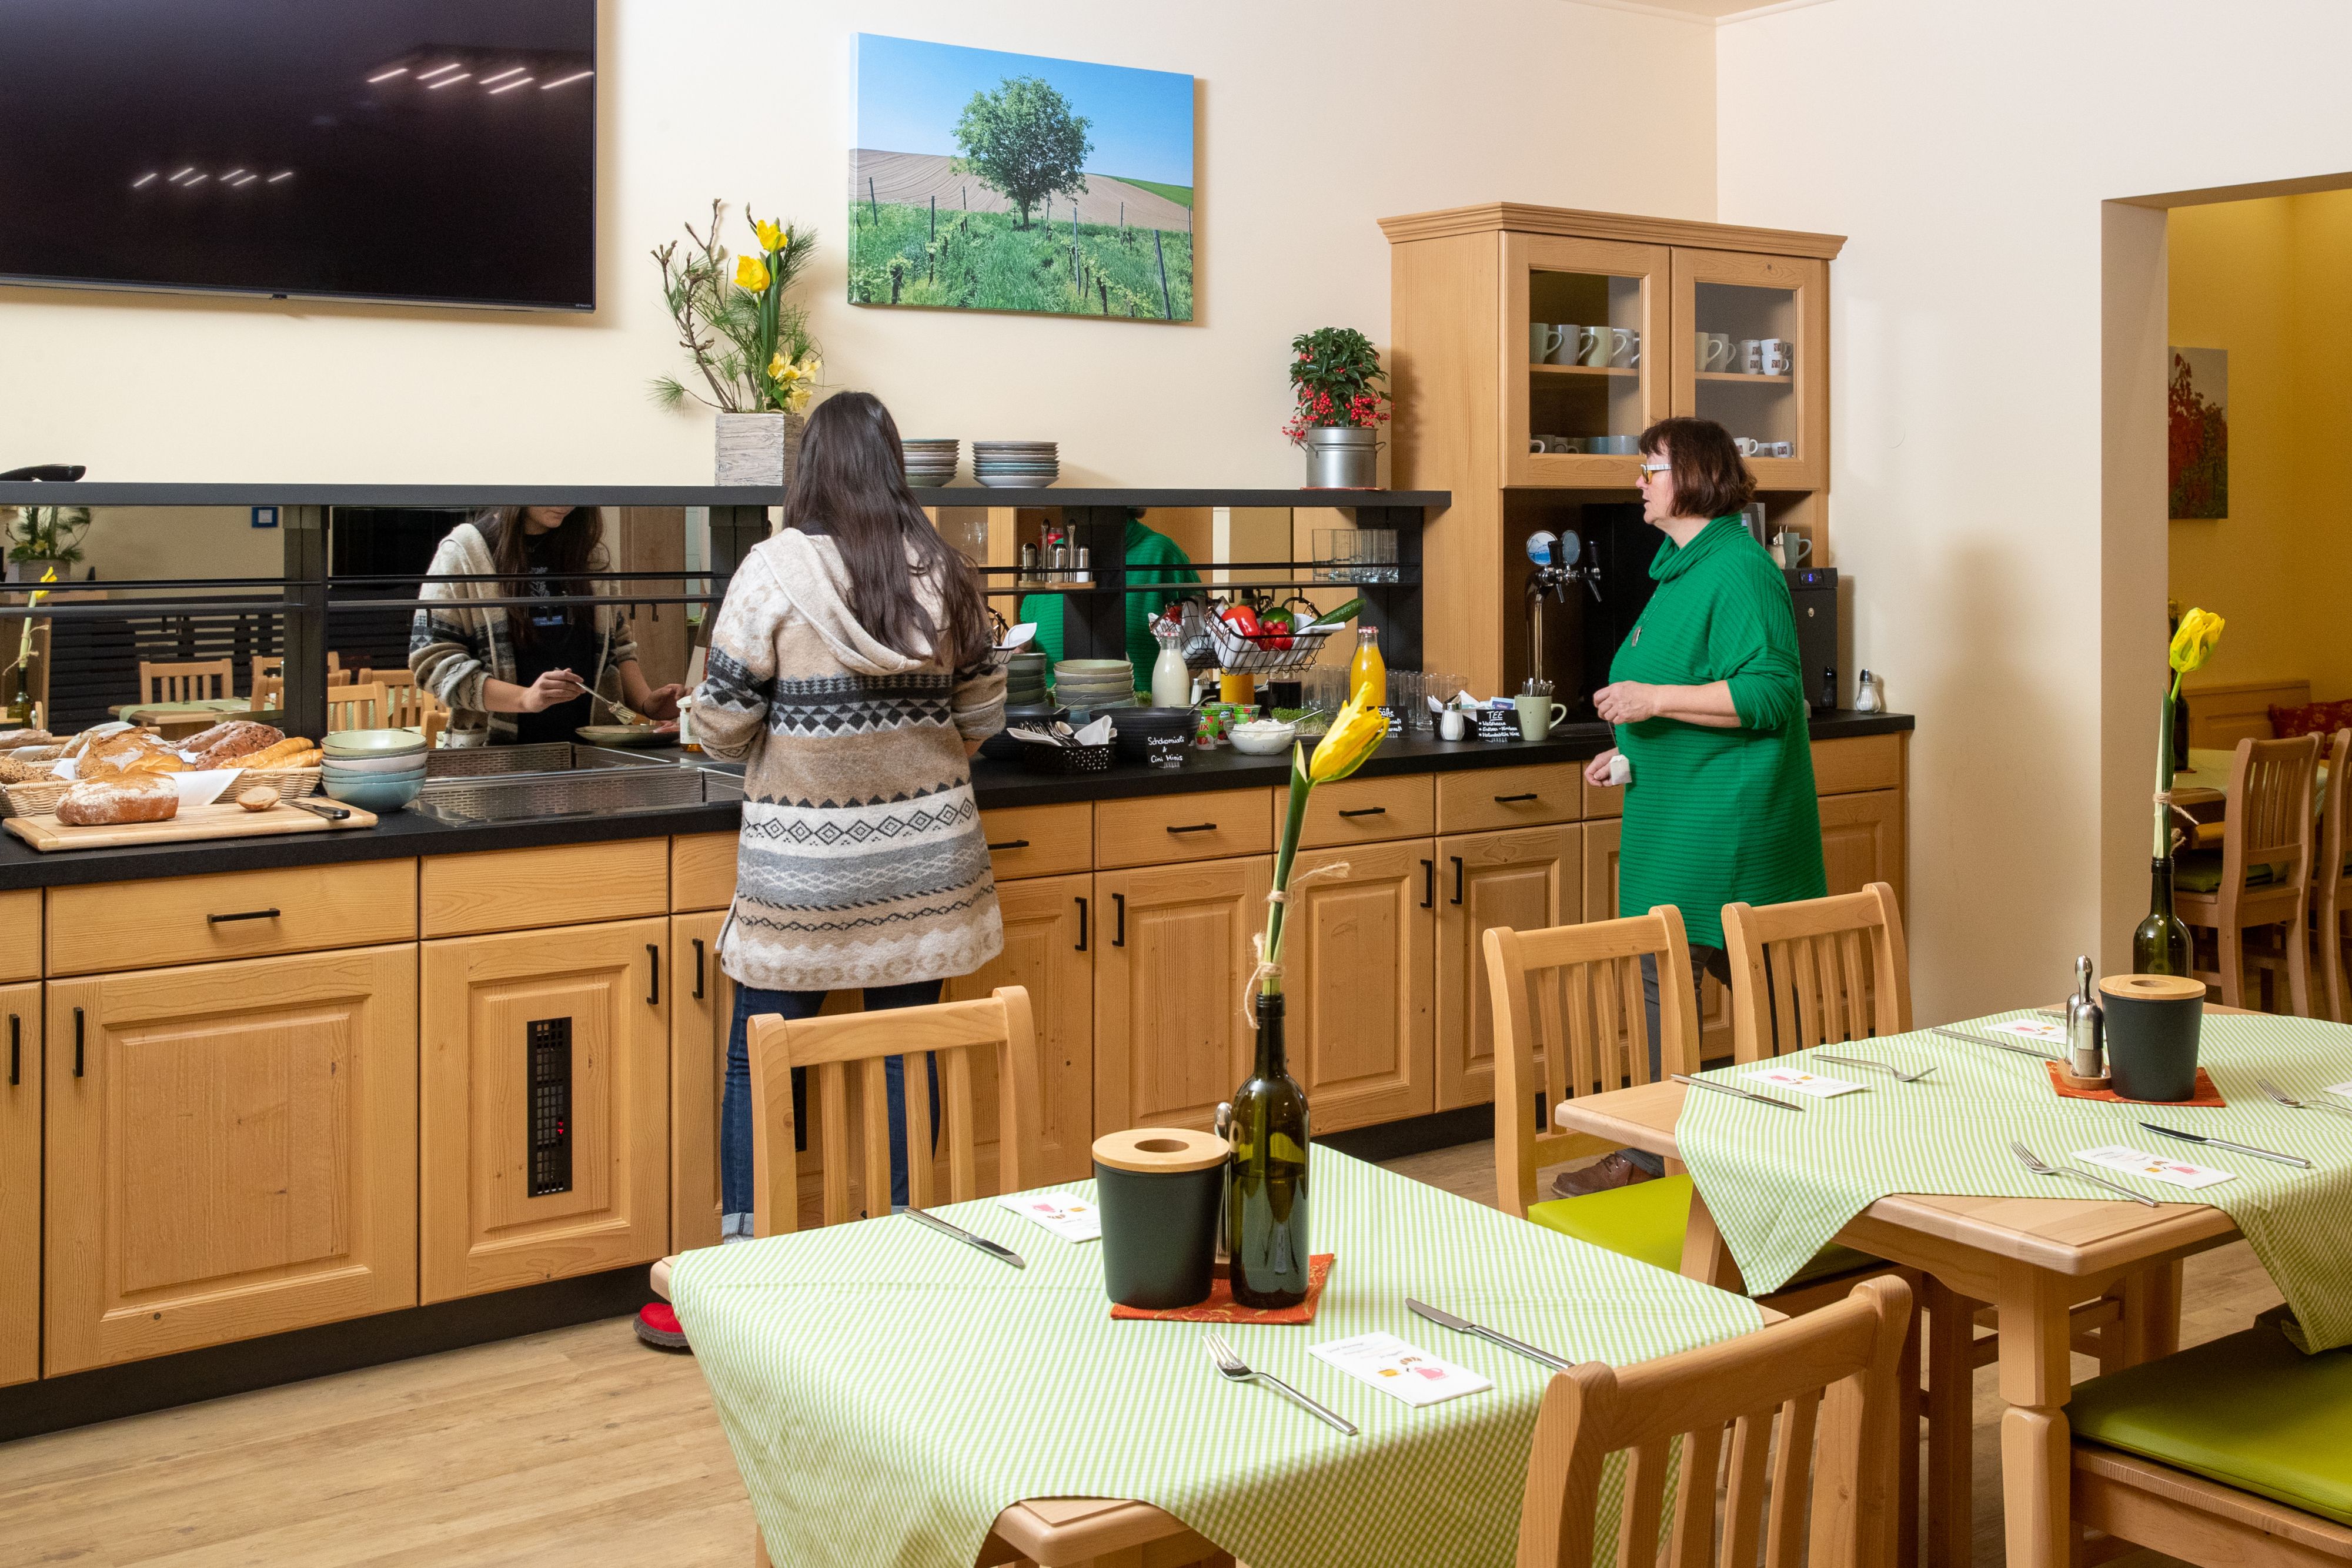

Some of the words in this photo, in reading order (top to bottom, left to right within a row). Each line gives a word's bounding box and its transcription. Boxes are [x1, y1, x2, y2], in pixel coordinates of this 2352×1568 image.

[1378, 707, 1394, 716] Säfte
[1486, 711, 1504, 719] TEE
[1151, 755, 1164, 763] Cini
